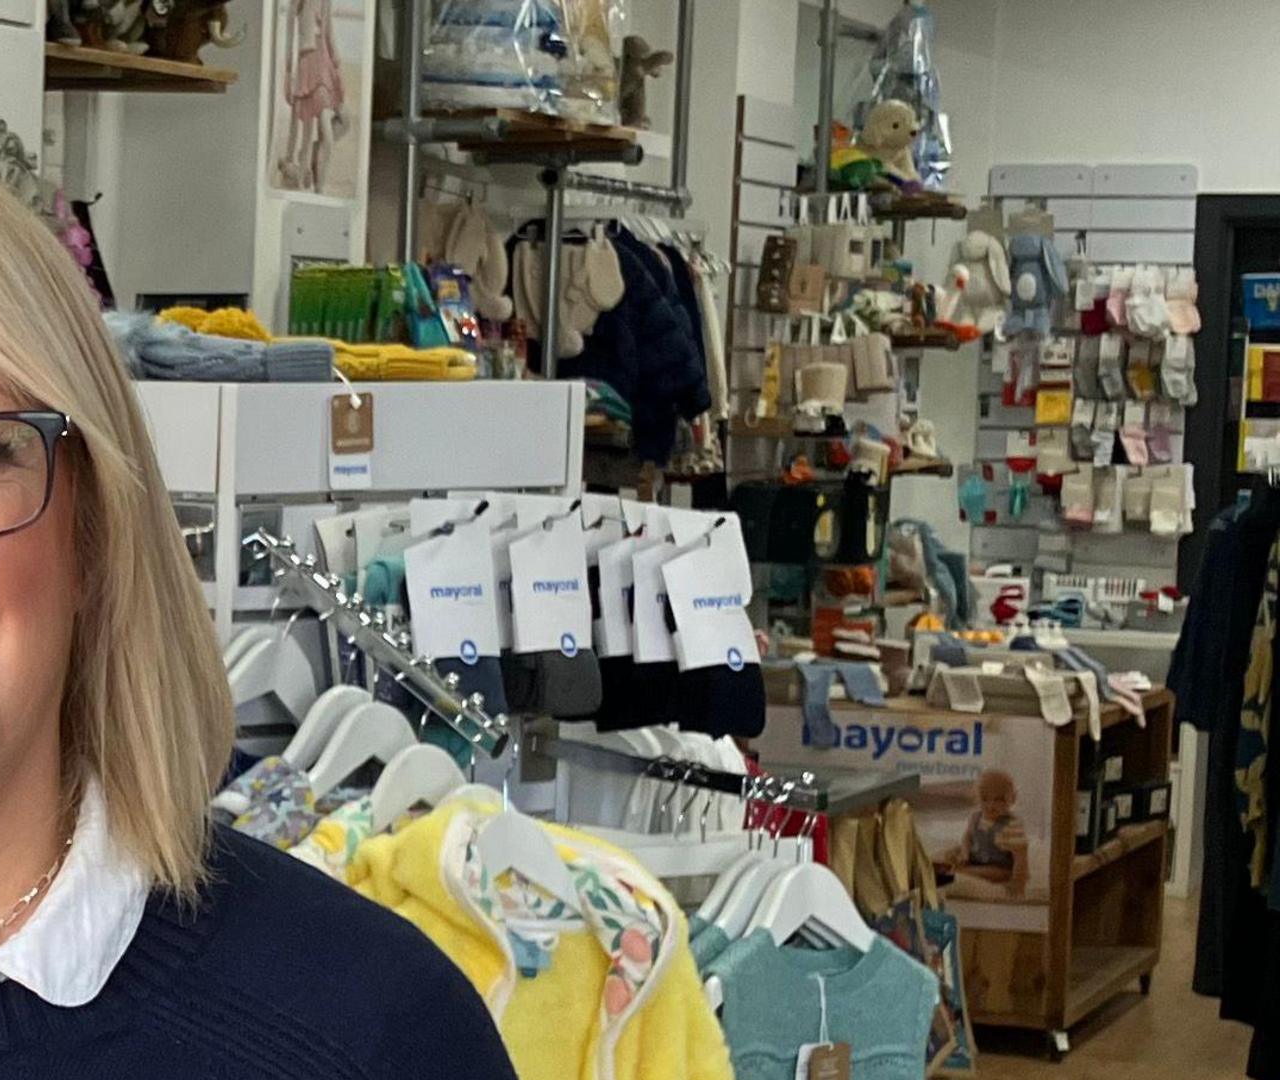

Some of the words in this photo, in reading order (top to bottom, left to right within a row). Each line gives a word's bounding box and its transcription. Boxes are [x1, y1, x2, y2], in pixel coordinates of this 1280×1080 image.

[430, 584, 482, 600] mayoral
[533, 579, 578, 594] mayoral
[693, 594, 742, 609] mayoral
